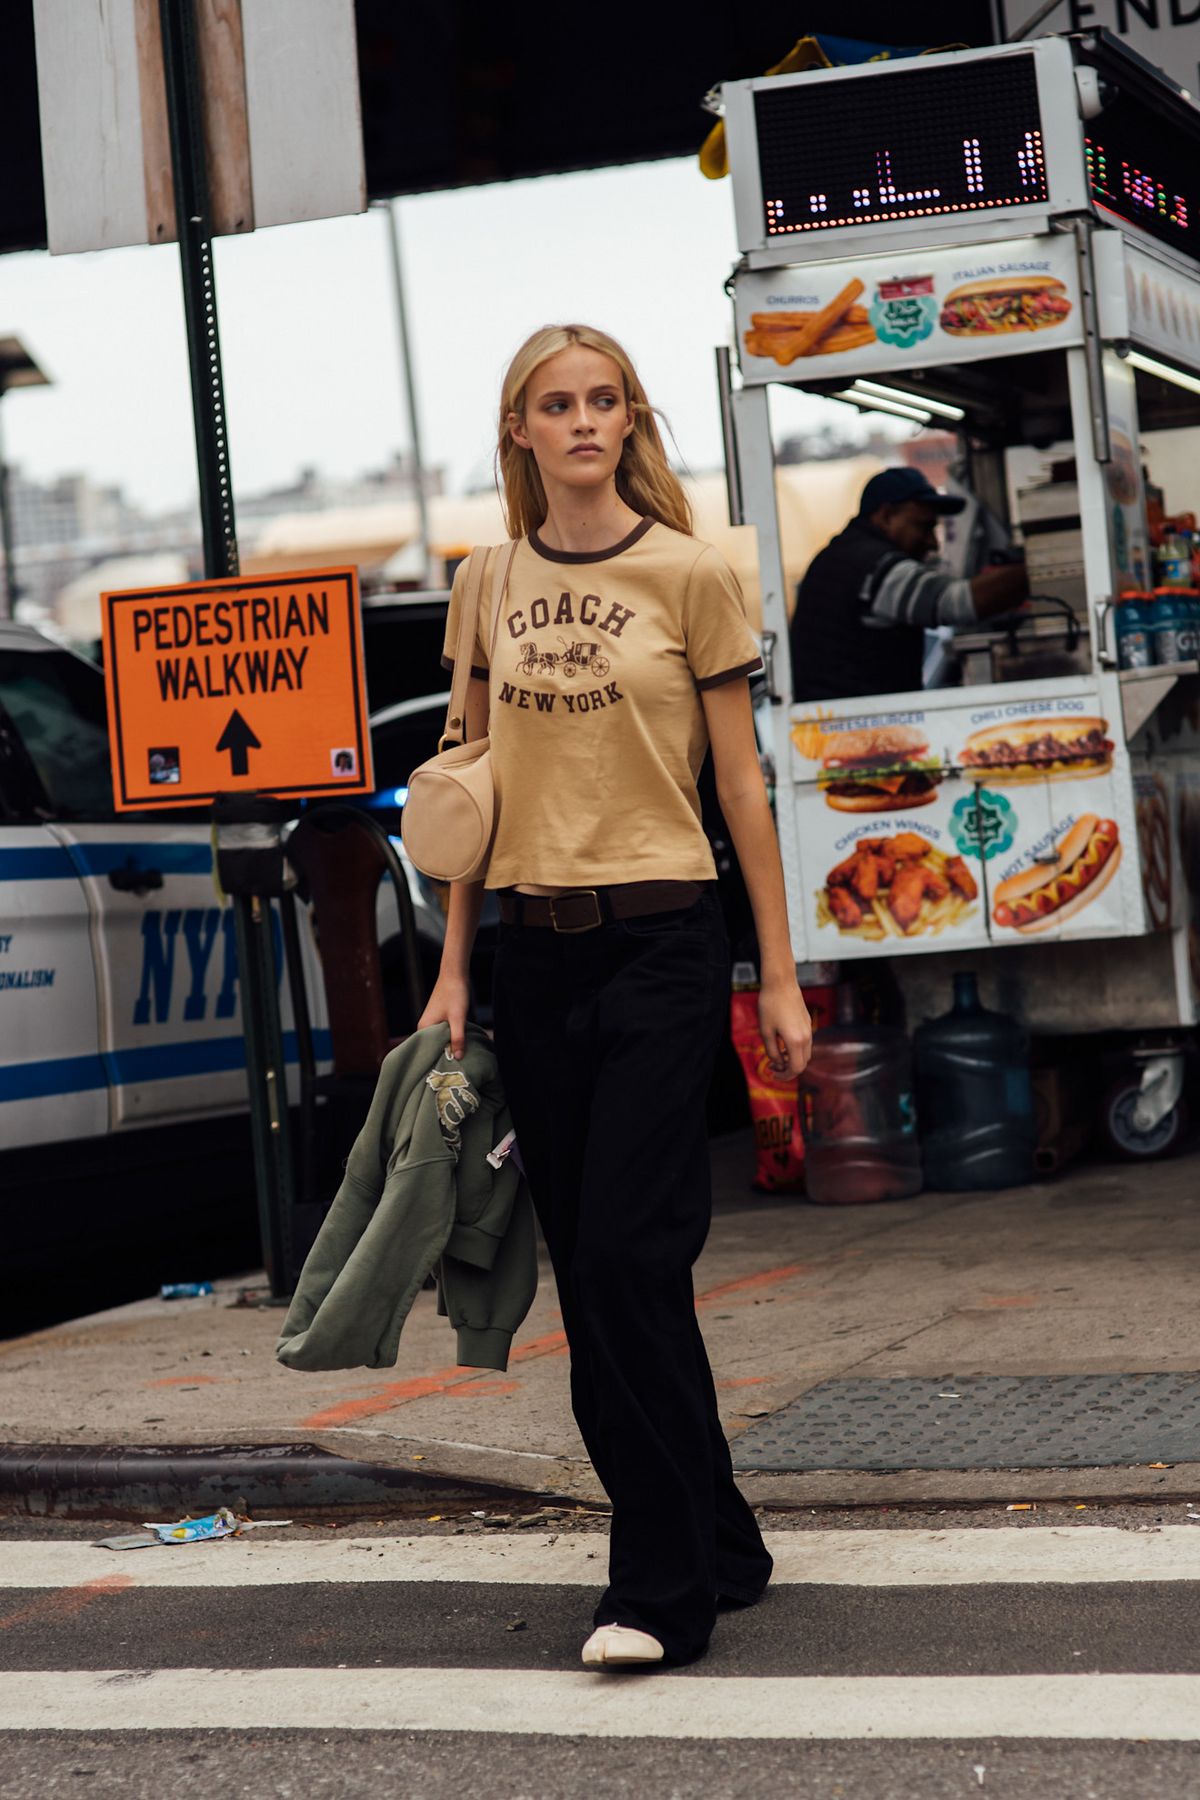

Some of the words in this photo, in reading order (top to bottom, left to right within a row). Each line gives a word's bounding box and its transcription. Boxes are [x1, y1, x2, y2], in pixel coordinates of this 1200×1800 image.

[766, 295, 820, 305] CHURROS
[133, 592, 329, 652] PEDESTRIAN
[507, 592, 636, 639] COACH
[156, 646, 309, 701] WALKWAY
[499, 681, 556, 713] NEW
[562, 681, 624, 713] YORK
[971, 708, 1003, 725] CHILI
[1005, 702, 1052, 717] CHEESE
[1057, 700, 1084, 712] DOG
[820, 711, 925, 734] CHEESEBURGER
[835, 820, 891, 851] CHICKEN
[895, 819, 941, 841] WINGS
[1000, 858, 1024, 882] HOT
[1024, 814, 1075, 861] SAUSAGE
[132, 908, 284, 1025] NYP
